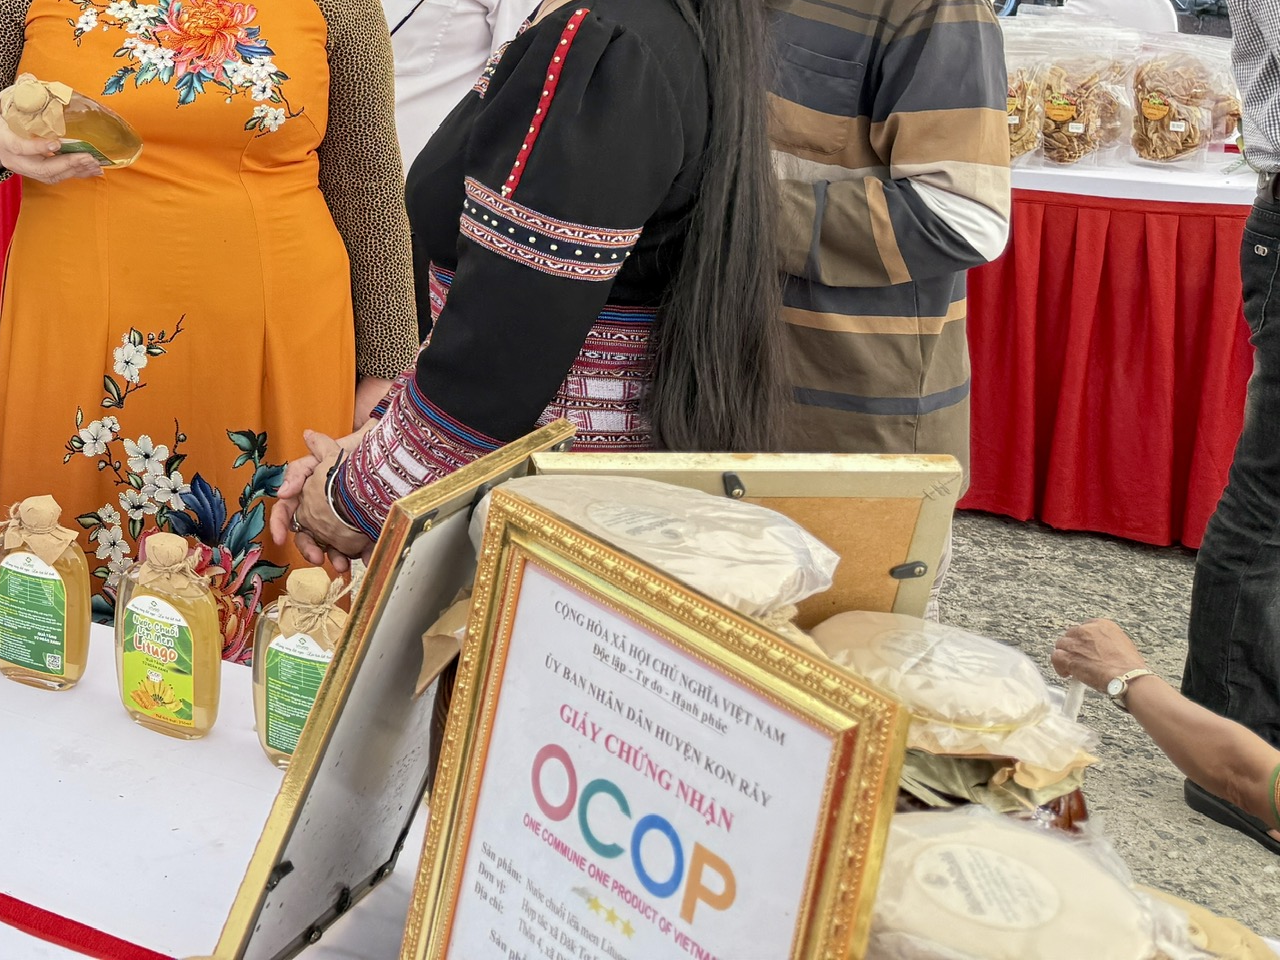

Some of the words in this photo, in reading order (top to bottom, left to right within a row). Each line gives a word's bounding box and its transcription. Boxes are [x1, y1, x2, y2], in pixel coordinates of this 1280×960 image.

[133, 614, 152, 629] Nước
[154, 622, 179, 637] Chuối
[134, 634, 178, 663] Litugo
[155, 633, 173, 647] Men
[554, 600, 585, 627] CỘNG
[586, 618, 609, 642] HÒA
[610, 632, 626, 653] XÃ
[629, 643, 651, 667] HỘI
[652, 658, 680, 682] CHỦ
[679, 671, 719, 708] NGHĨA
[722, 697, 754, 726] VIỆT
[754, 719, 786, 746] NAM
[593, 643, 610, 662] Độc
[612, 654, 627, 674] lập
[636, 668, 650, 687] Tự
[651, 679, 663, 695] do
[671, 690, 699, 717] Hạnh
[700, 705, 728, 734] phúc
[545, 652, 562, 674] ỦY
[562, 666, 587, 691] BAN
[587, 682, 624, 715] NHÂN
[626, 706, 653, 733] DÂN
[655, 724, 703, 766] HUYỆN
[704, 755, 736, 787] KON
[559, 703, 603, 744] GIẤY
[604, 733, 673, 792] CHỨNG
[675, 778, 735, 833] NHẬN
[531, 743, 737, 926] OCOP
[474, 880, 488, 903] Địa
[478, 861, 494, 883] Đơn
[481, 841, 496, 861] Sản
[497, 859, 522, 884] phẩm:
[525, 878, 545, 903] Nước
[523, 813, 542, 837] ONE
[541, 828, 588, 872] COMMUNE
[588, 863, 611, 889] ONE
[610, 878, 659, 924] PRODUCT
[658, 916, 673, 935] OF
[489, 929, 508, 953] Sản
